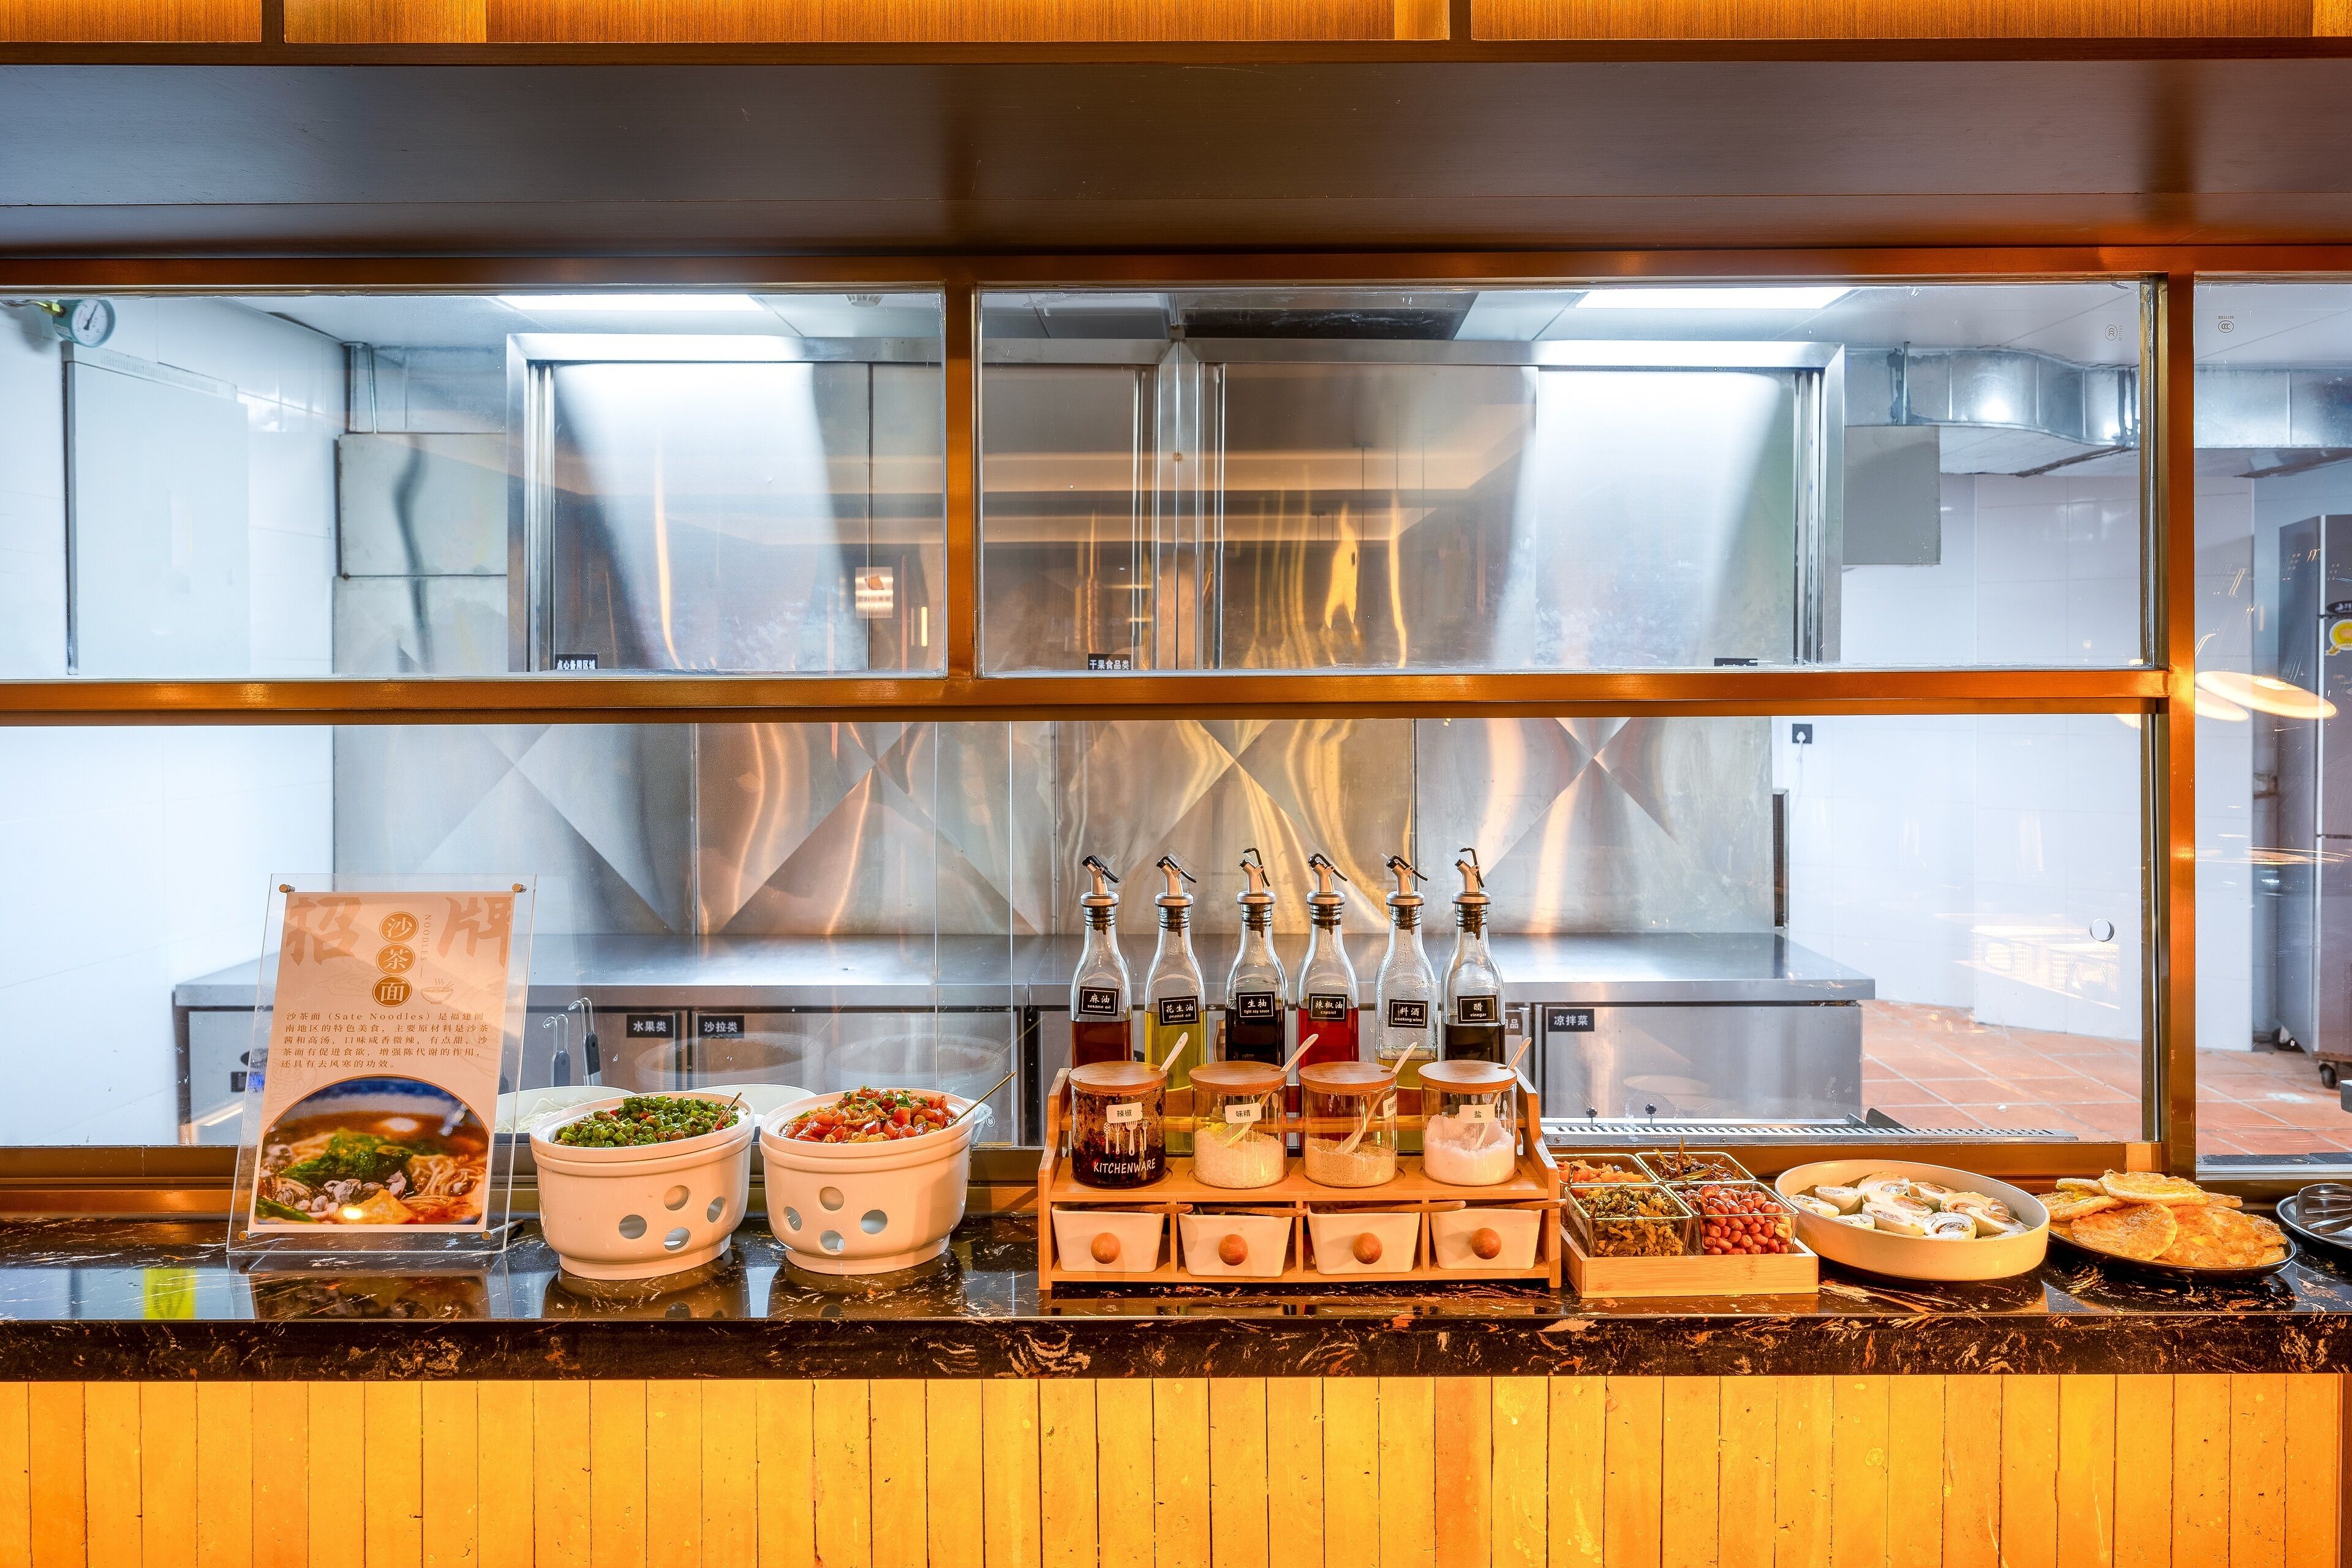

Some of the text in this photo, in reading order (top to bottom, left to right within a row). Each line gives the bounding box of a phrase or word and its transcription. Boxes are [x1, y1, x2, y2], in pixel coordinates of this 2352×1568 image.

[1089, 660, 1129, 670] 干果食品类
[420, 914, 431, 962] NOODLES
[380, 917, 413, 1003] 沙茶面
[1089, 993, 1110, 1004] 麻油
[1248, 998, 1267, 1008] 生抽
[1166, 1003, 1194, 1013] 花生油
[1314, 1000, 1343, 1009] 辣椒油
[1473, 1001, 1483, 1011] 醋
[1399, 1006, 1420, 1017] 料酒
[1554, 1015, 1588, 1026] 凉拌菜
[633, 1020, 667, 1032] 水果类
[704, 1021, 738, 1033] 沙拉类
[1117, 1109, 1133, 1118] 辣椒
[1235, 1109, 1251, 1118] 味精
[1474, 1110, 1482, 1118] 盐
[1093, 1158, 1156, 1175] KITCHENWARE
